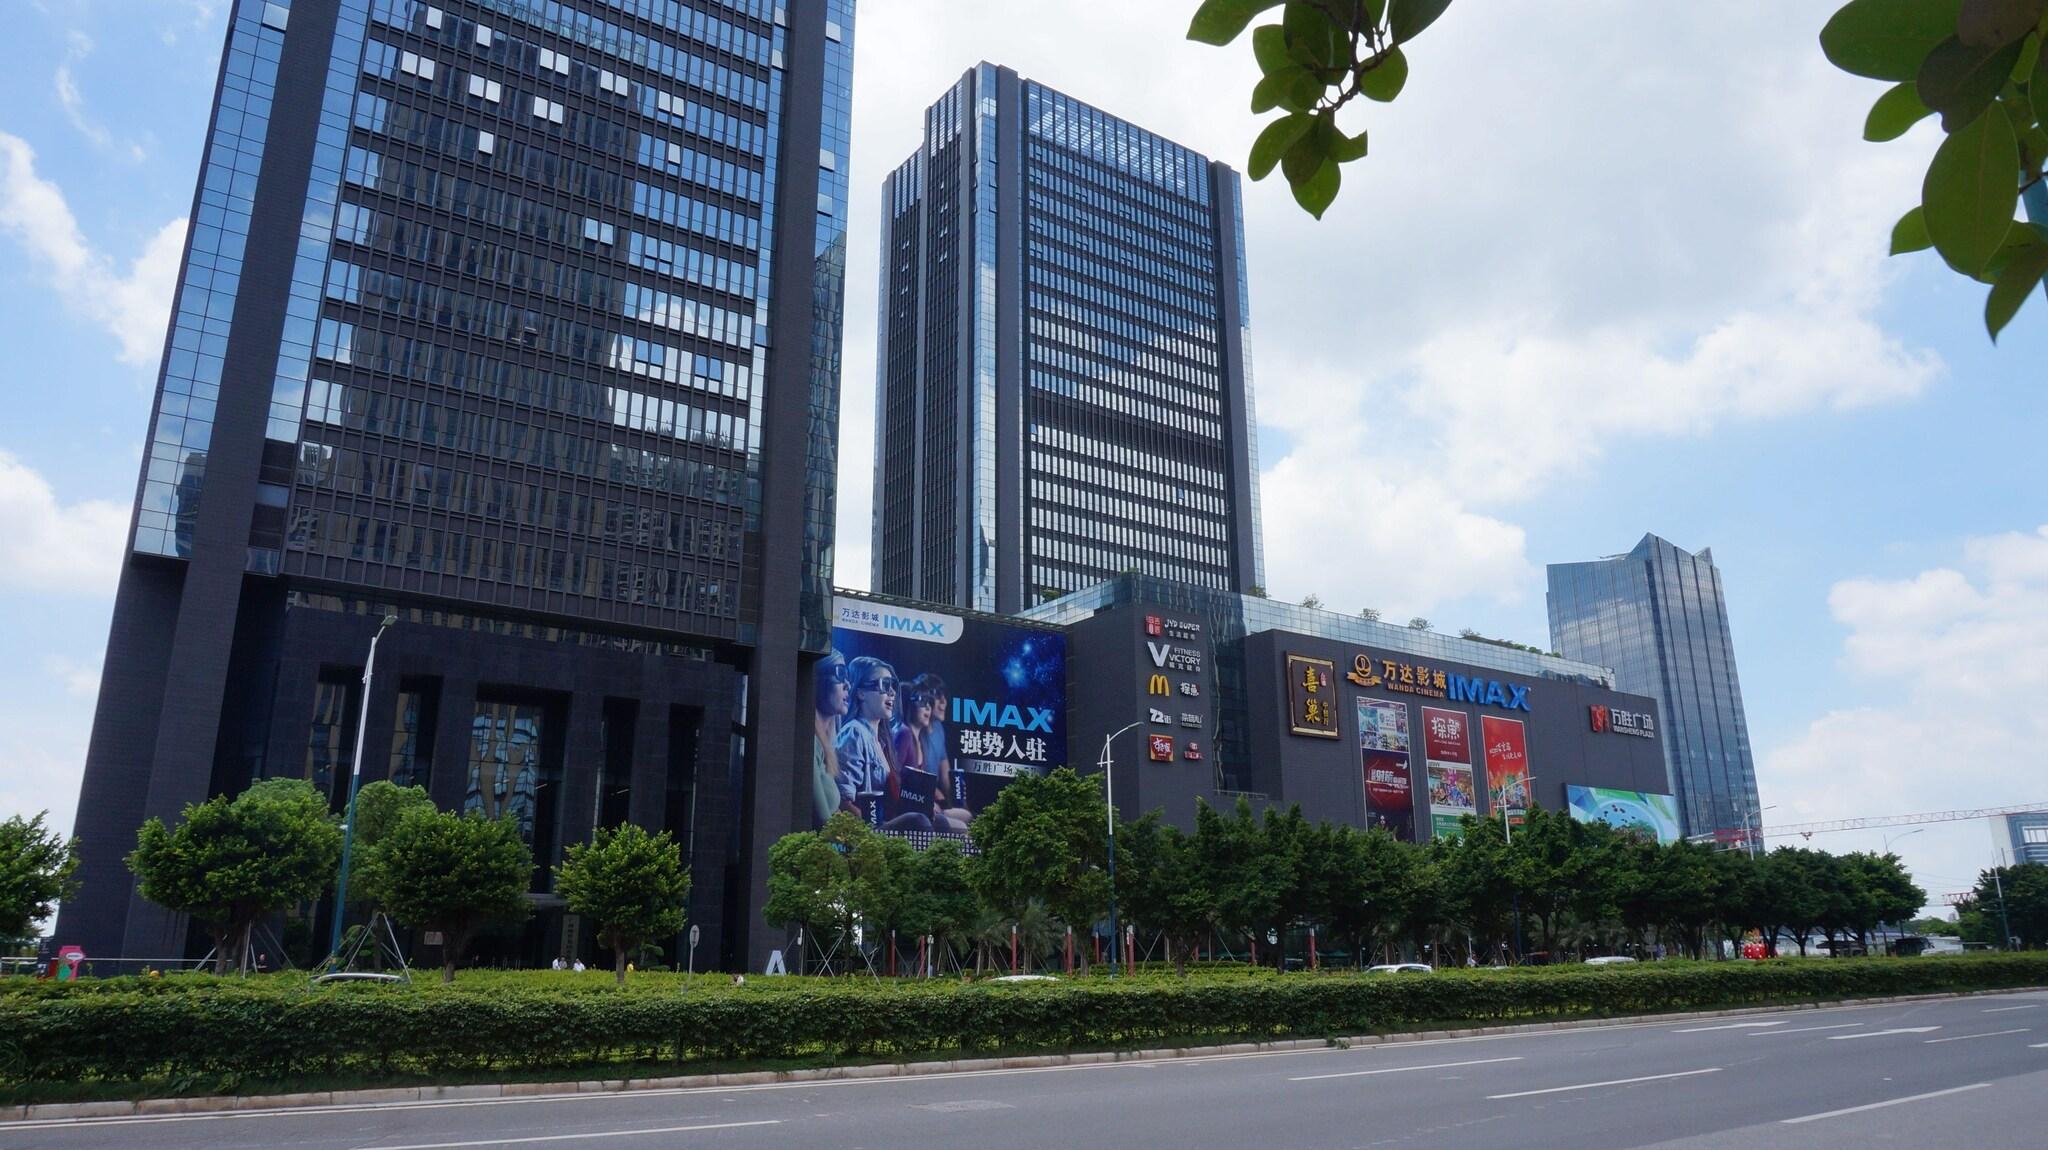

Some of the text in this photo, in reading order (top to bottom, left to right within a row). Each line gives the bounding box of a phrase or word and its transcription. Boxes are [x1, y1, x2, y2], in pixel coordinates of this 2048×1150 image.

[842, 607, 880, 622] 万达影城
[883, 614, 944, 637] IMAX
[1168, 653, 1201, 665] VICTORY
[1174, 647, 1200, 657] FITNESS
[1382, 660, 1447, 689] 万达影城
[1302, 666, 1320, 723] 喜巢
[1387, 682, 1445, 698] WANDA CINEMA
[1448, 672, 1532, 711] IMAX
[953, 697, 1053, 733] IMAX
[1611, 708, 1654, 730] 万胜广场
[1639, 729, 1655, 738] PLAZA
[960, 729, 1047, 762] 强势入驻
[900, 789, 925, 803] IMAX
